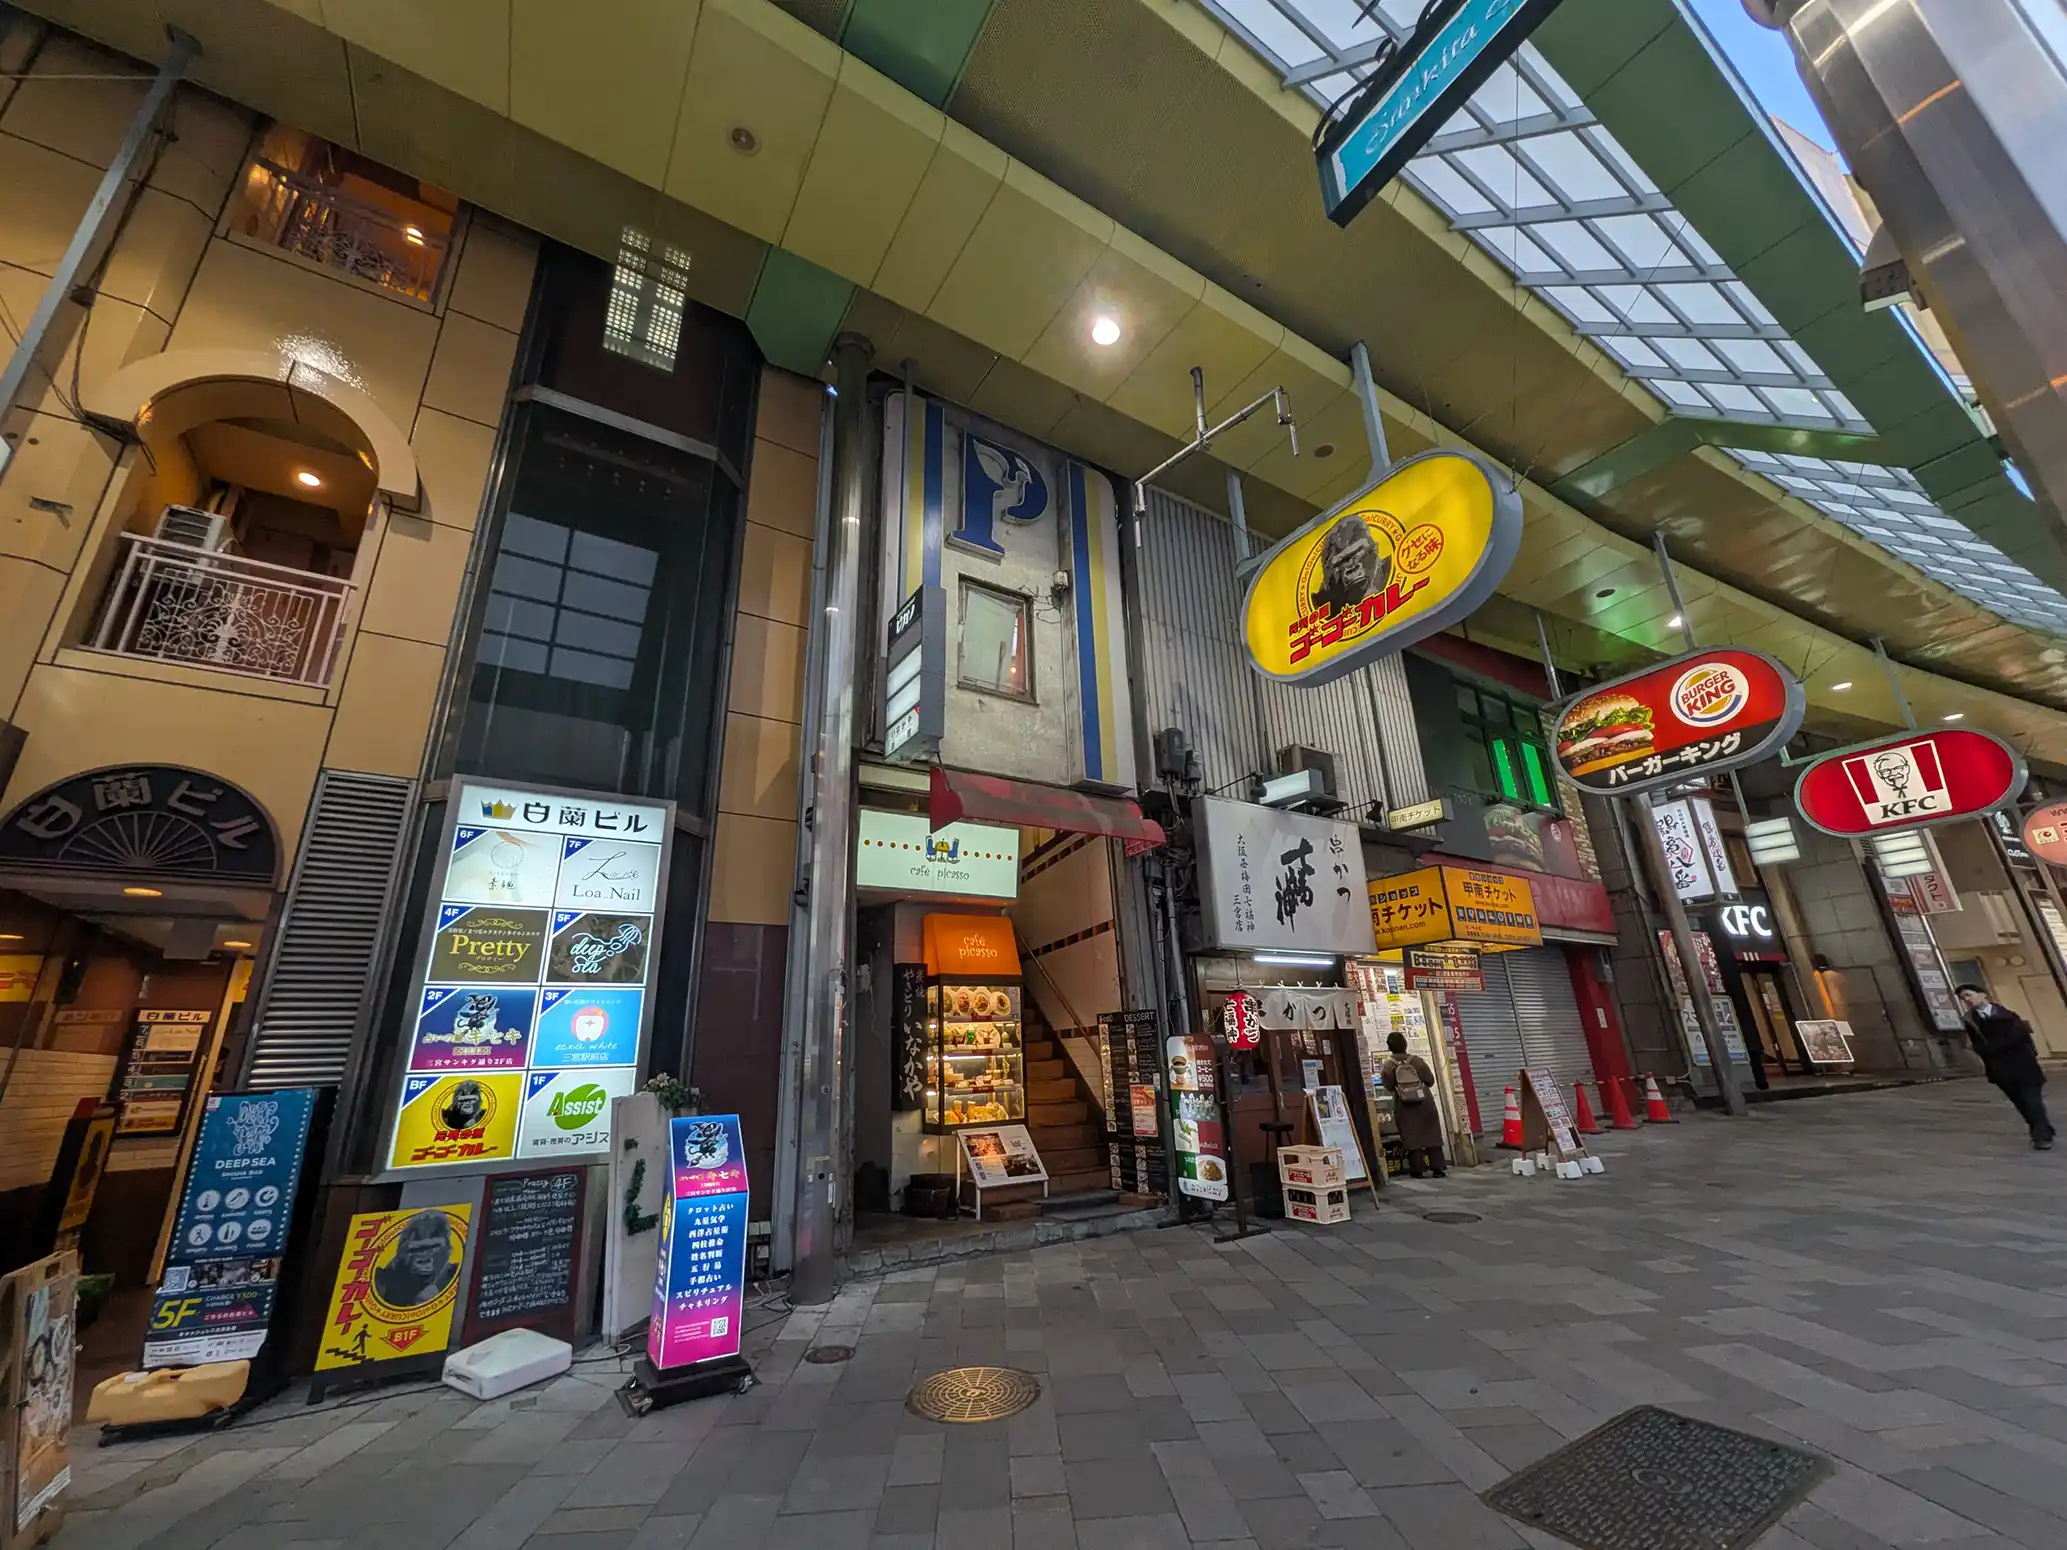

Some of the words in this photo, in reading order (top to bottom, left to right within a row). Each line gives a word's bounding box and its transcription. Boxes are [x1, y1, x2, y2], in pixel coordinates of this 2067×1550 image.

[1290, 577, 1430, 664] ゴーゴーカレー
[1681, 671, 1730, 705] BURGER
[1686, 679, 1736, 717] KING
[1609, 732, 1741, 784] バーガーキング
[16, 772, 261, 849] 白蘭ビル
[1881, 795, 1937, 819] KFC
[523, 802, 648, 833] 白蘭ビル
[1391, 805, 1441, 824] 甲南チケット
[460, 830, 474, 839] 6F
[569, 840, 583, 849] 7F
[937, 868, 970, 880] picasso
[1329, 833, 1351, 904] 串かつ
[1462, 881, 1517, 903] 甲南チケット
[444, 908, 460, 917] 4F
[557, 914, 571, 922] 5F
[1721, 905, 1772, 937] KFC
[449, 934, 532, 963] Pretty
[570, 936, 608, 958] deep
[959, 946, 998, 960] picasso
[427, 990, 443, 1000] 2F
[544, 991, 560, 1001] 3F
[146, 1012, 204, 1021] 白蘭ビル
[1124, 1011, 1154, 1022] DESSERT
[562, 1052, 610, 1062] 三宮駅前店
[903, 1021, 923, 1101] いなかや
[409, 1081, 427, 1090] BF
[533, 1076, 545, 1085] 1F
[546, 1092, 604, 1117] Assist
[411, 1142, 499, 1161] ゴーゴーカレー
[555, 1178, 572, 1189] 4F
[688, 1203, 734, 1215] タロット占い
[688, 1225, 729, 1238] 西洋占星術
[692, 1237, 724, 1250] 四柱推命
[691, 1249, 723, 1261] 姓名判断
[690, 1273, 721, 1285] 手相占い
[675, 1283, 732, 1299] スピリチュアル
[679, 1296, 728, 1311] チャネリング
[152, 1297, 202, 1329] 5F
[394, 1330, 417, 1341] B1F
